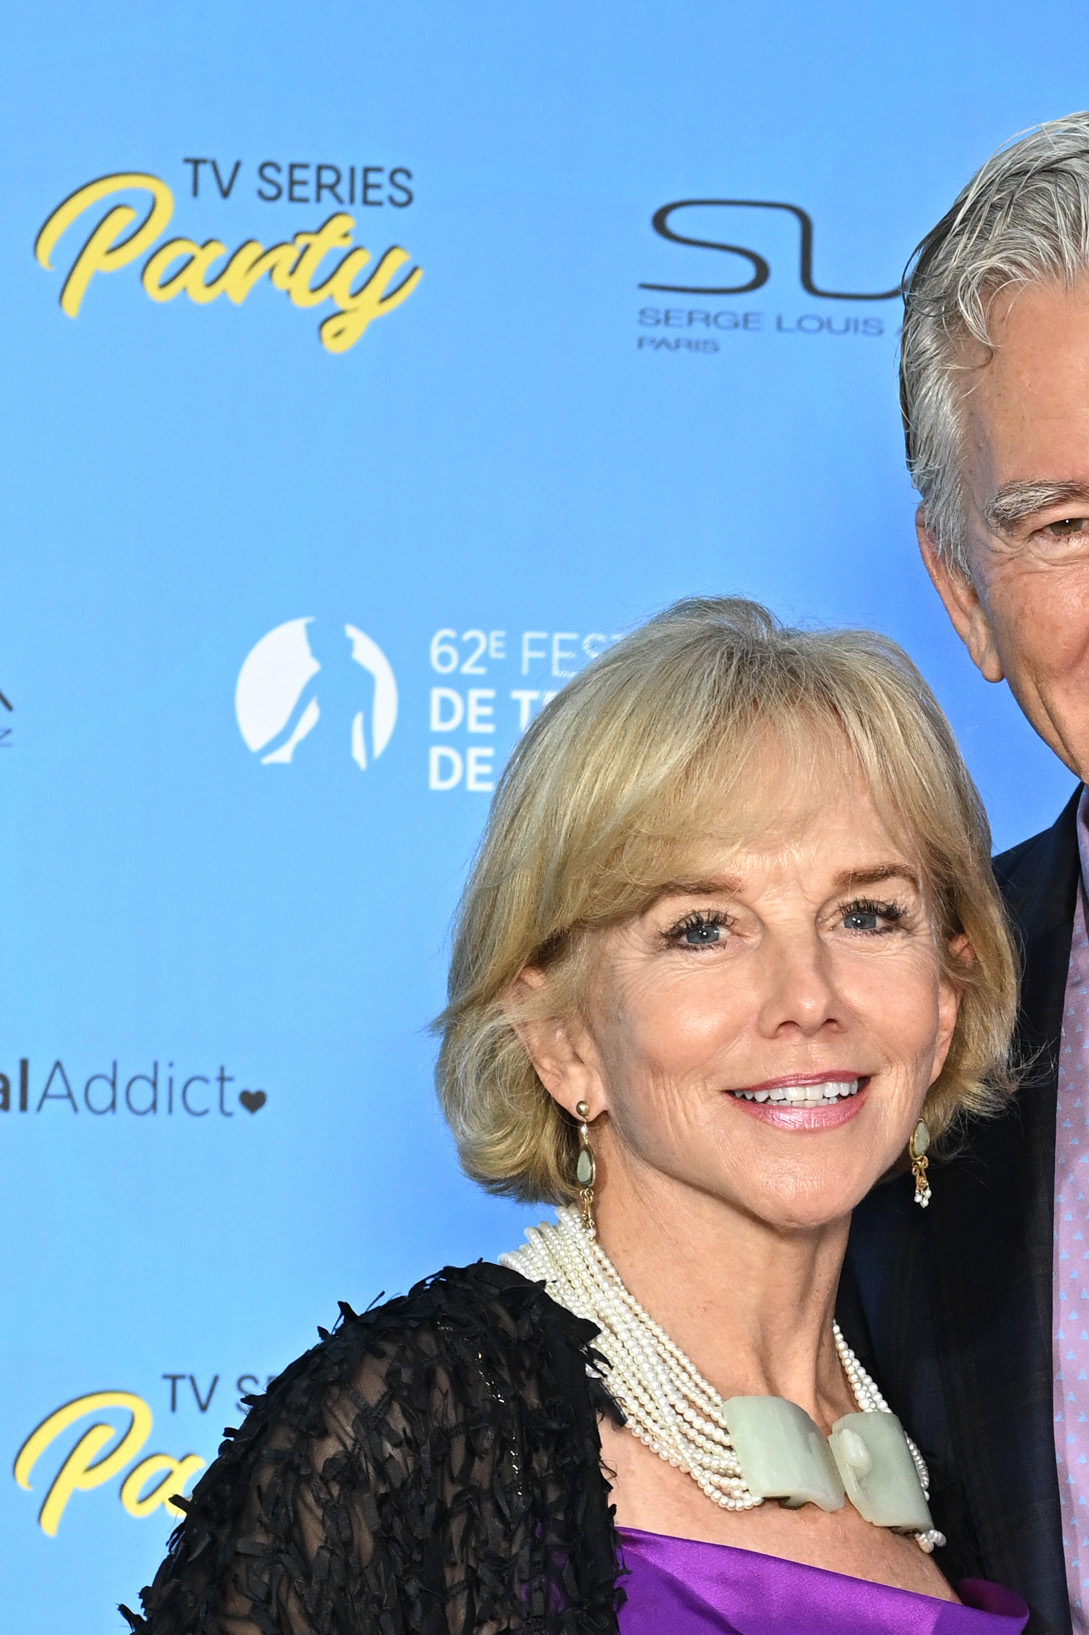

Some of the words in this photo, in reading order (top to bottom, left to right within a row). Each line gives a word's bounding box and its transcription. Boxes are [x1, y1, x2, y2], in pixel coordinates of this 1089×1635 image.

[183, 157, 241, 199] TV
[257, 161, 414, 208] SERIES
[33, 171, 424, 353] Party
[638, 198, 906, 301] SL
[637, 307, 764, 332] SERGE
[775, 312, 885, 337] LOUIS
[637, 335, 720, 354] PARIS
[429, 687, 496, 734] DE
[428, 745, 494, 792] DE
[162, 1373, 220, 1414] TV
